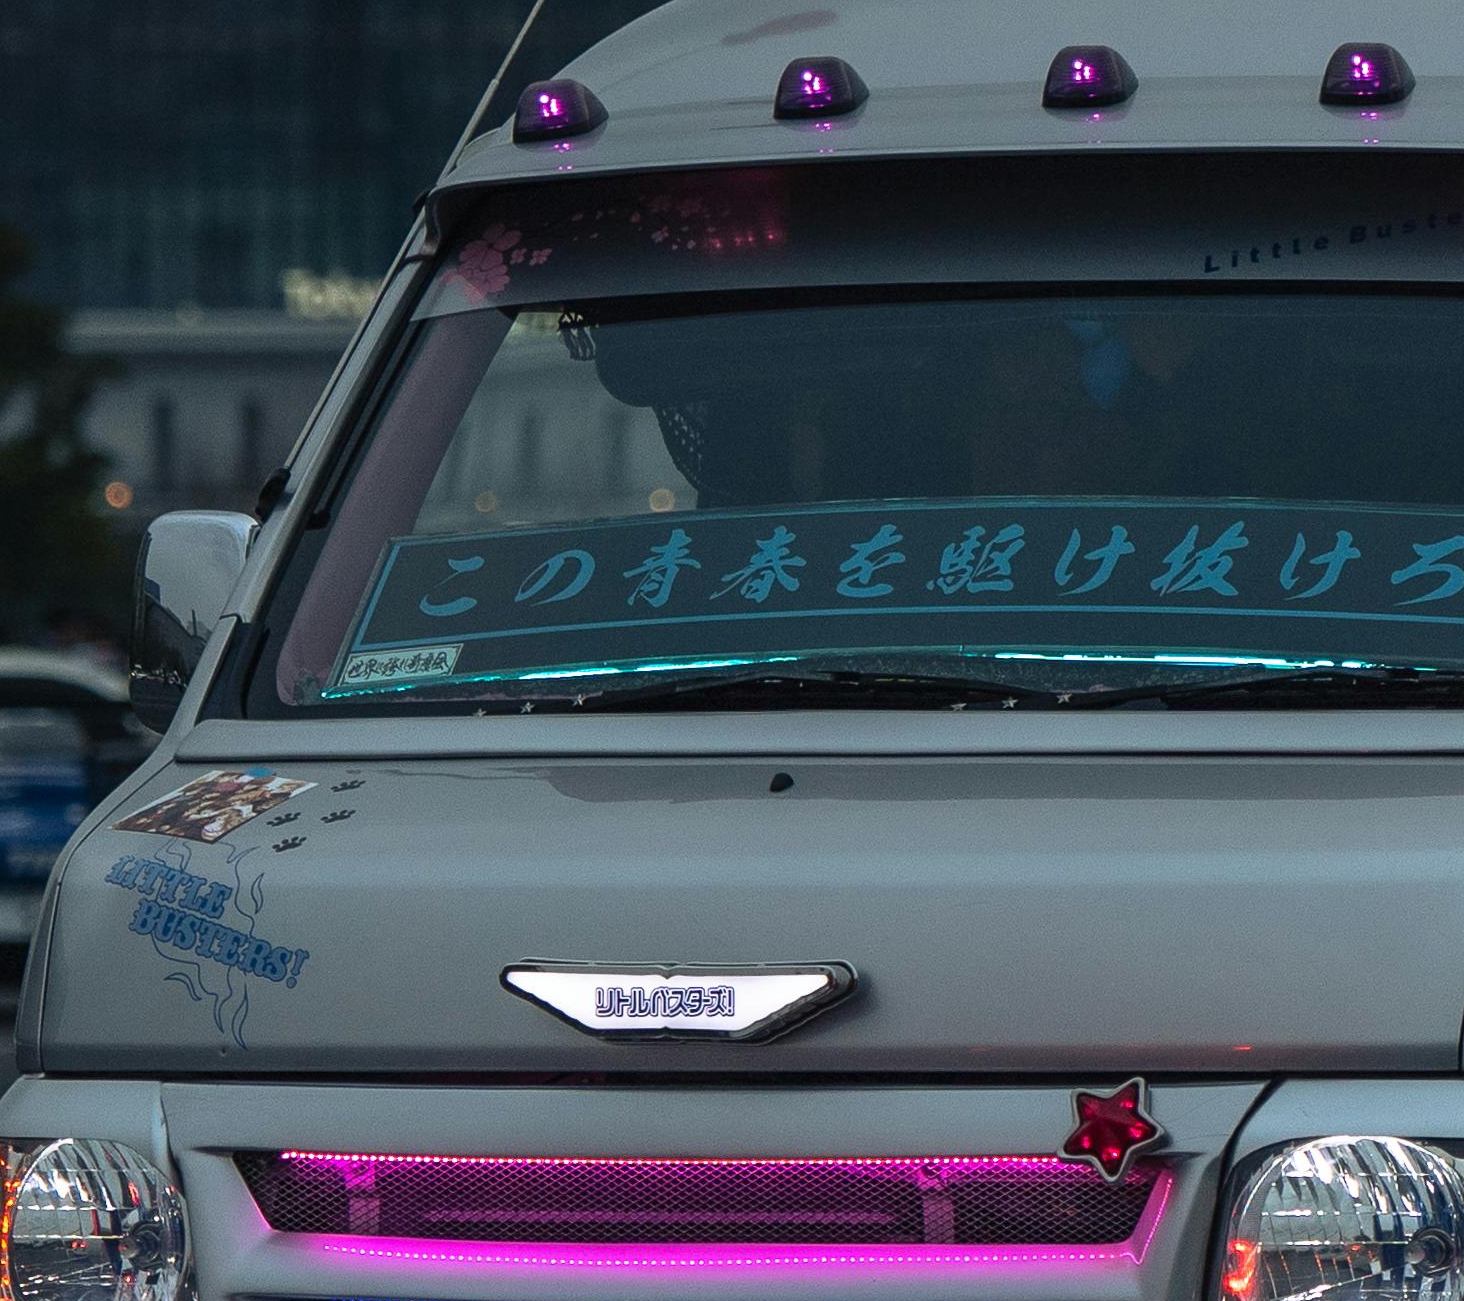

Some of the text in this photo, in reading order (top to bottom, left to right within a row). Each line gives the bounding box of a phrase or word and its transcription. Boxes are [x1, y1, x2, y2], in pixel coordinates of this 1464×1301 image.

[1204, 235, 1329, 274] Little
[105, 854, 233, 919] LITTLE
[129, 898, 310, 989] BUSTERS!
